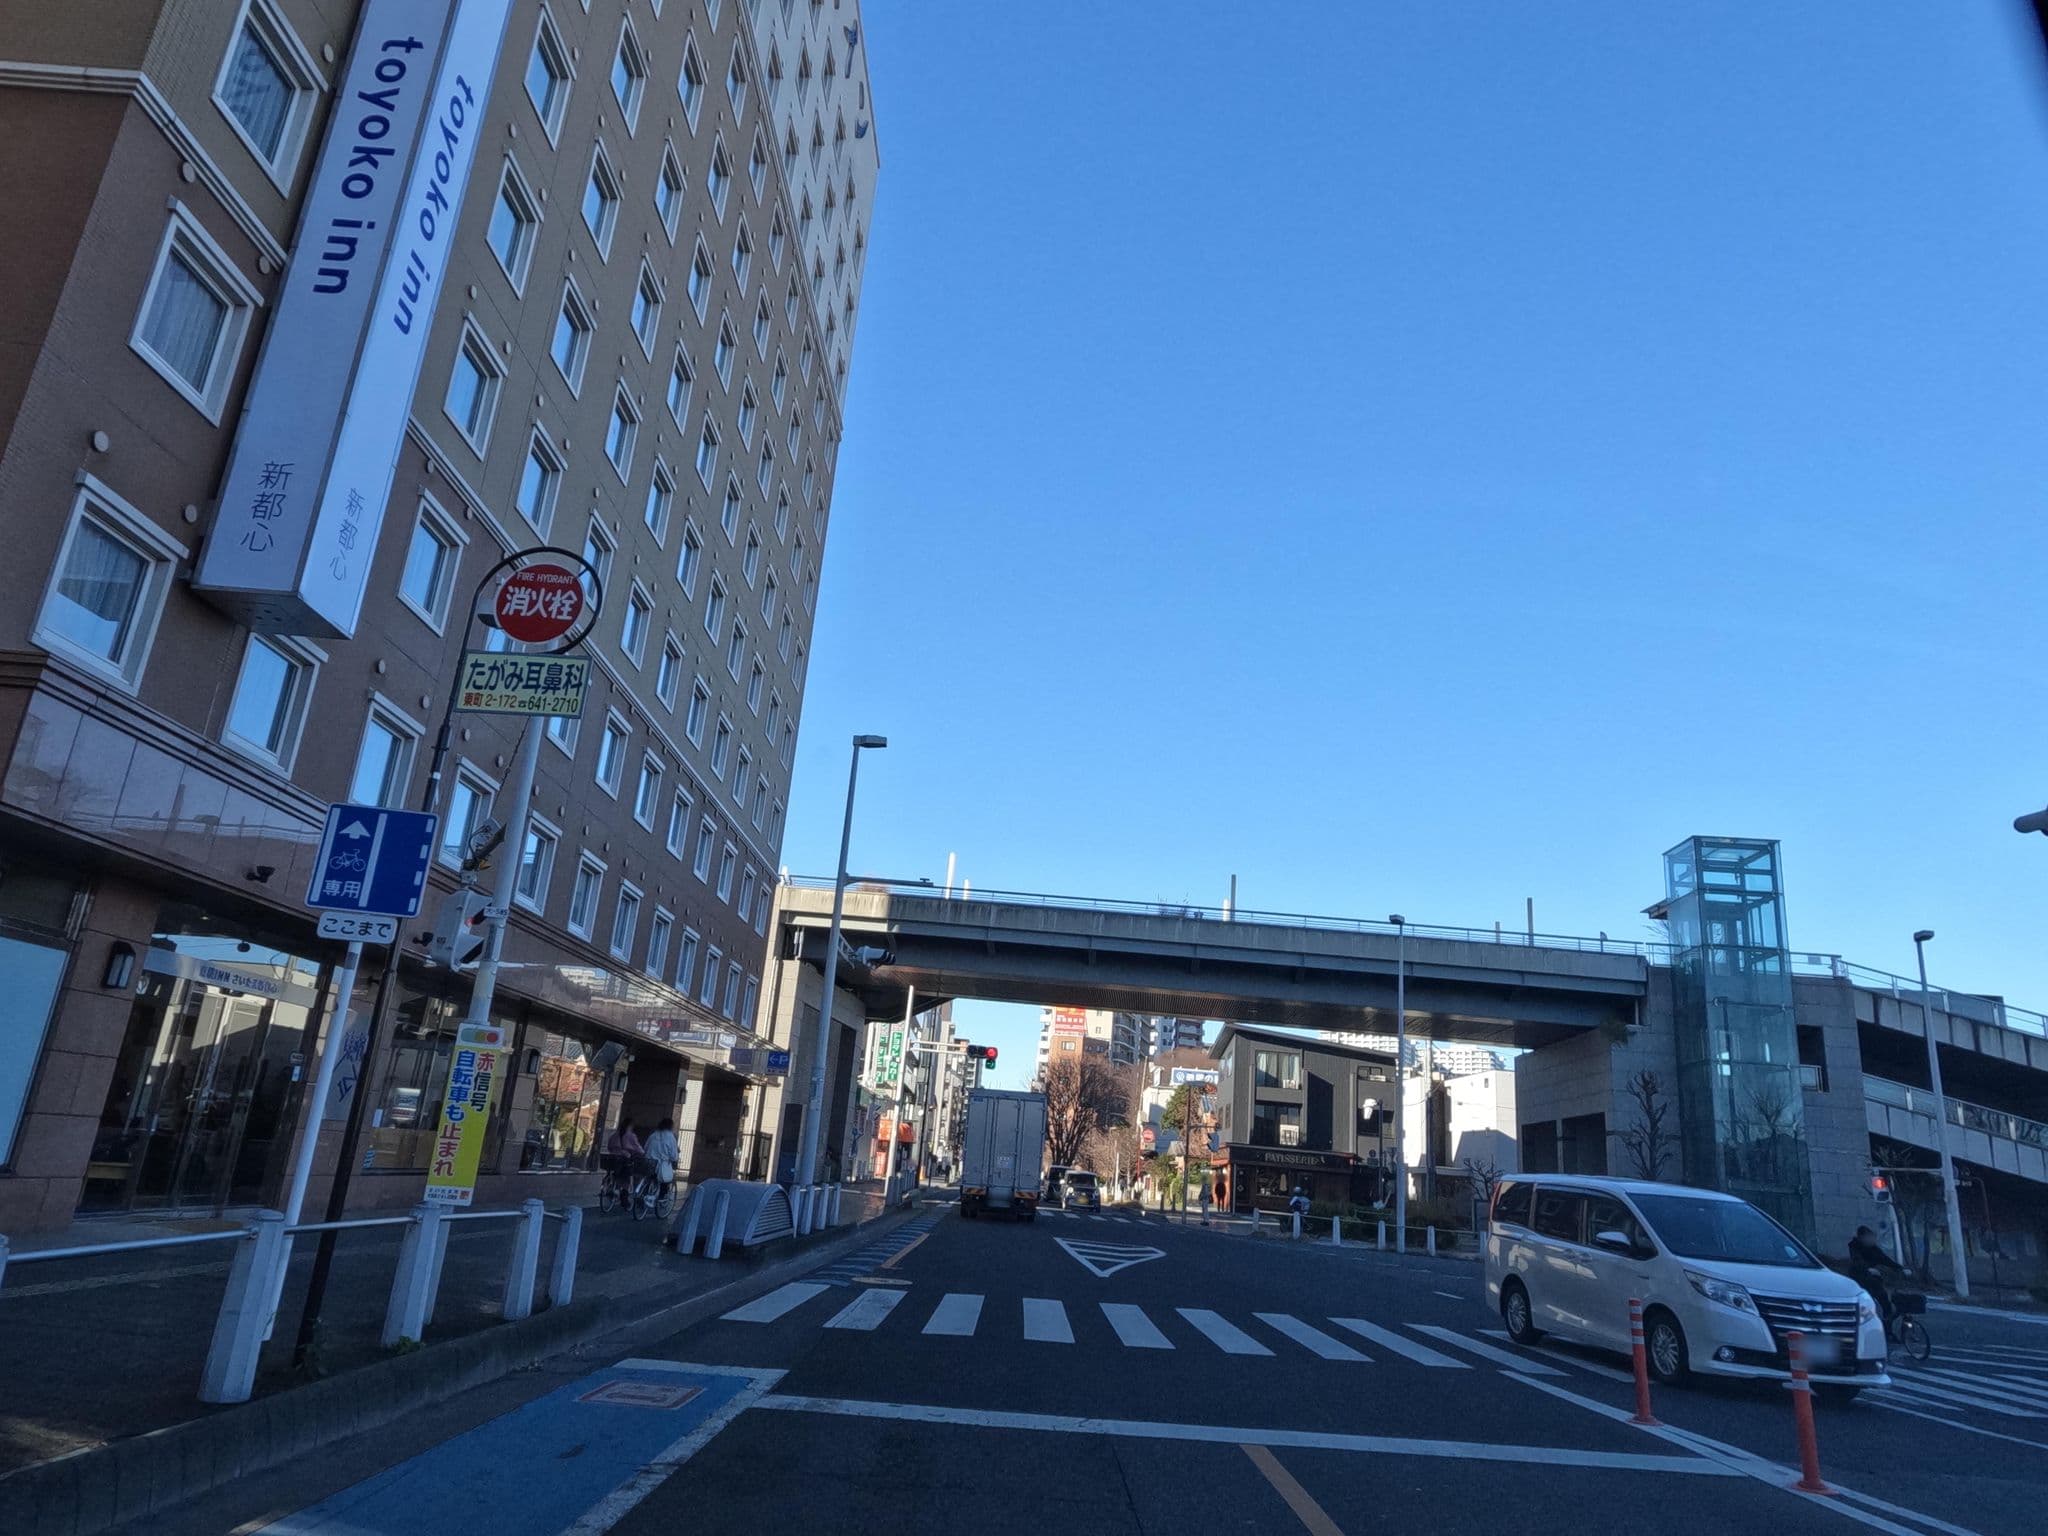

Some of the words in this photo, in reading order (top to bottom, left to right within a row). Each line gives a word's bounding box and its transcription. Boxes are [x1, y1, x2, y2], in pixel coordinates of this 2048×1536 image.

[340, 36, 424, 200] toyoko
[420, 74, 475, 242] toyoko
[312, 217, 376, 294] inn
[393, 249, 431, 336] inn
[240, 460, 295, 552] 新都心
[329, 487, 366, 582] 新都心
[501, 586, 578, 621] 消火栓
[516, 571, 535, 582] FIRE
[537, 573, 574, 585] HYDRANT
[465, 658, 584, 697] たがみ耳鼻科
[322, 879, 362, 899] 専用
[322, 917, 392, 938] ここまで
[433, 1050, 476, 1177] 自転車も止まれ
[469, 1051, 496, 1113] 赤信号
